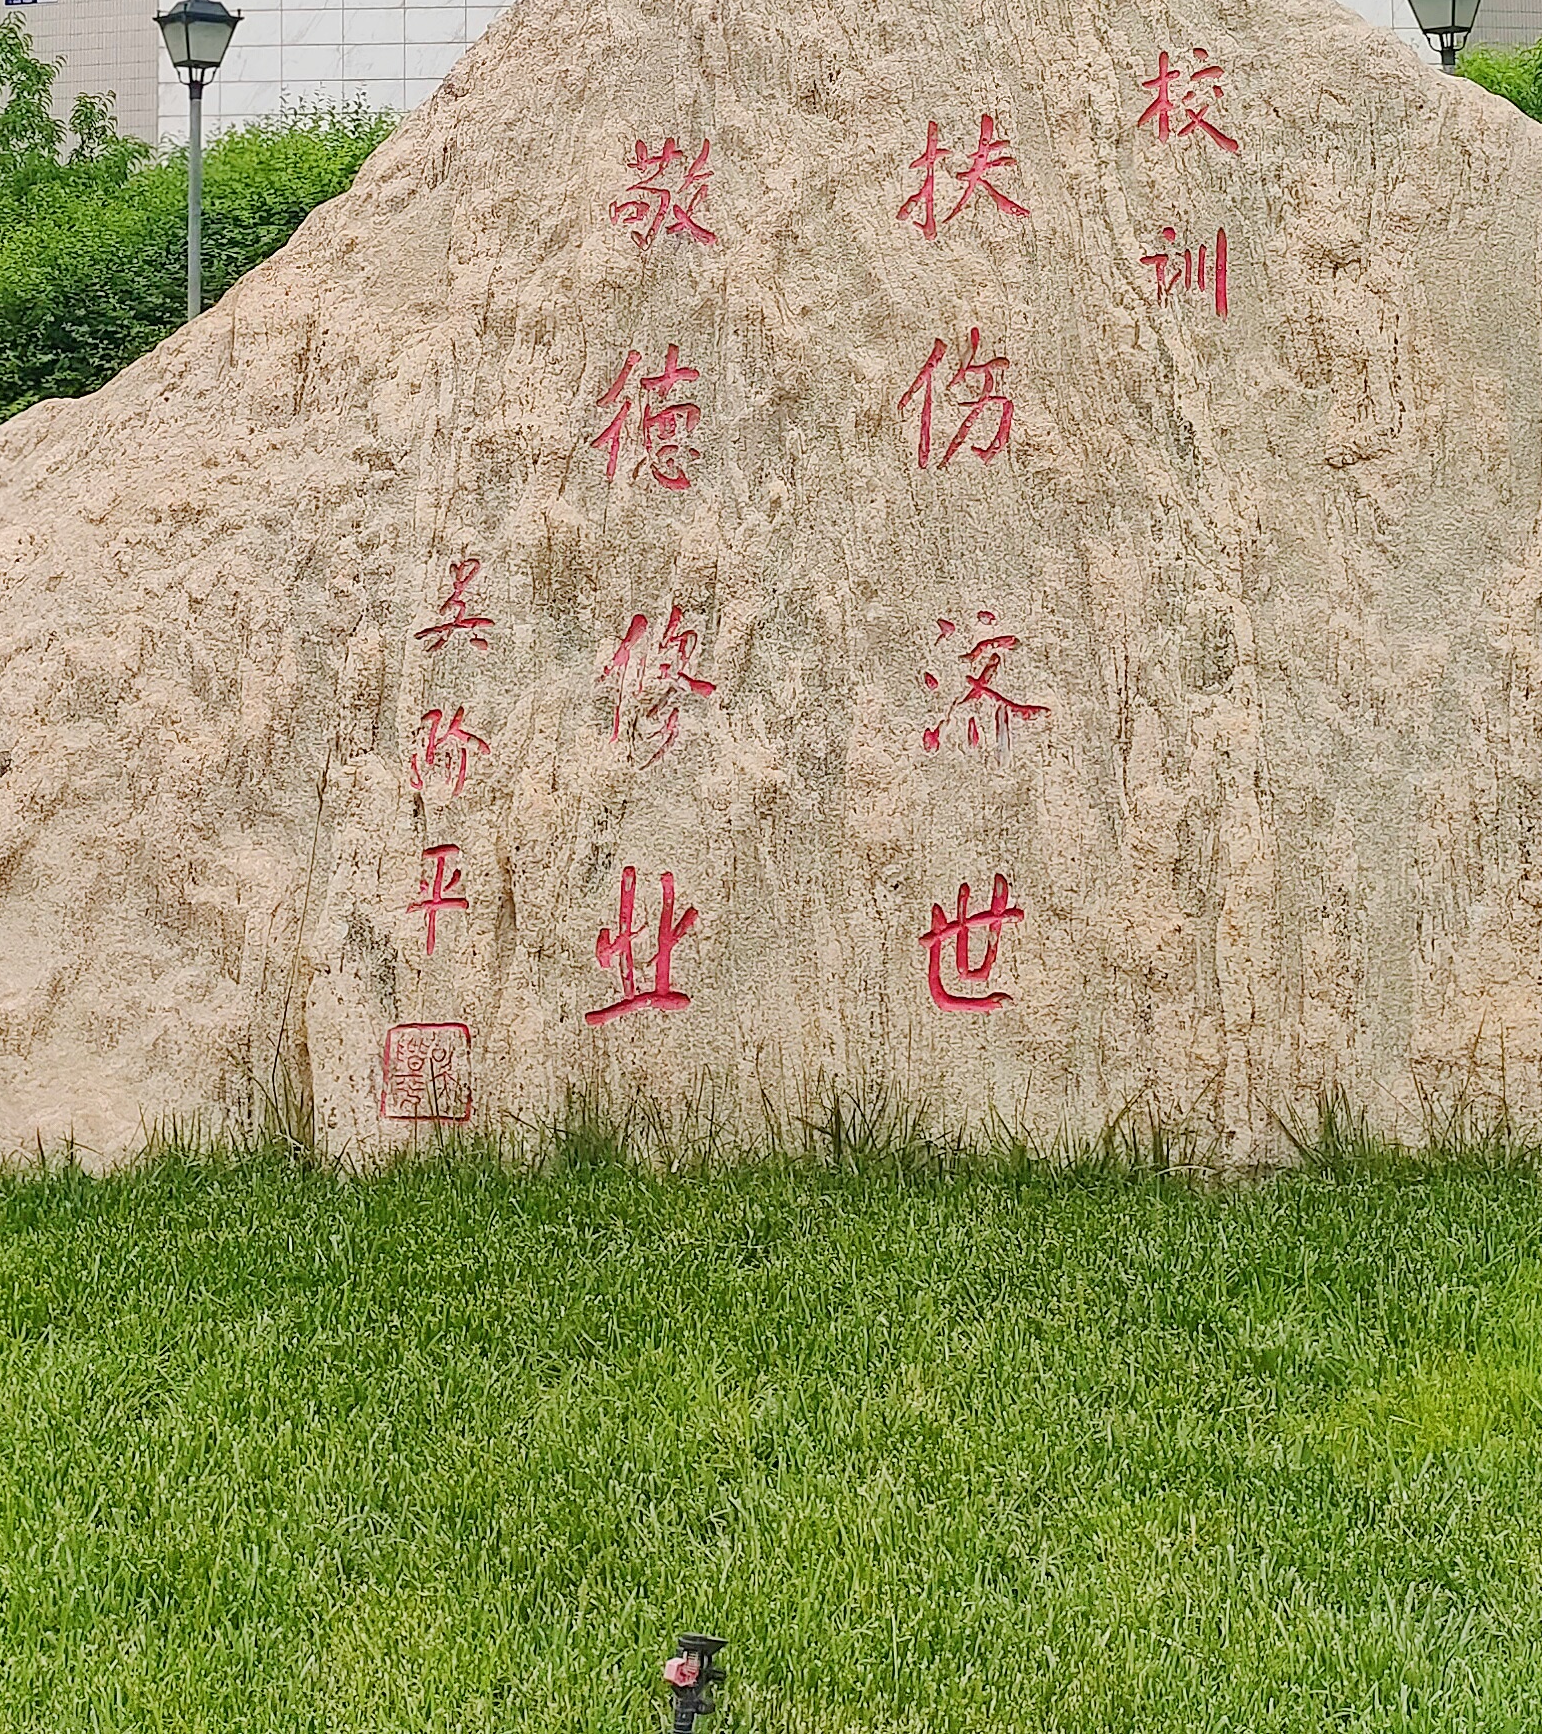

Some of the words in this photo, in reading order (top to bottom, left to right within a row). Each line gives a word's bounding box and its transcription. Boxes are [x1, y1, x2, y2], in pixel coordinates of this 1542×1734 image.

[585, 137, 718, 1026] 敬德修业
[896, 112, 1051, 1015] 扶伤济世
[1137, 48, 1239, 318] 校训
